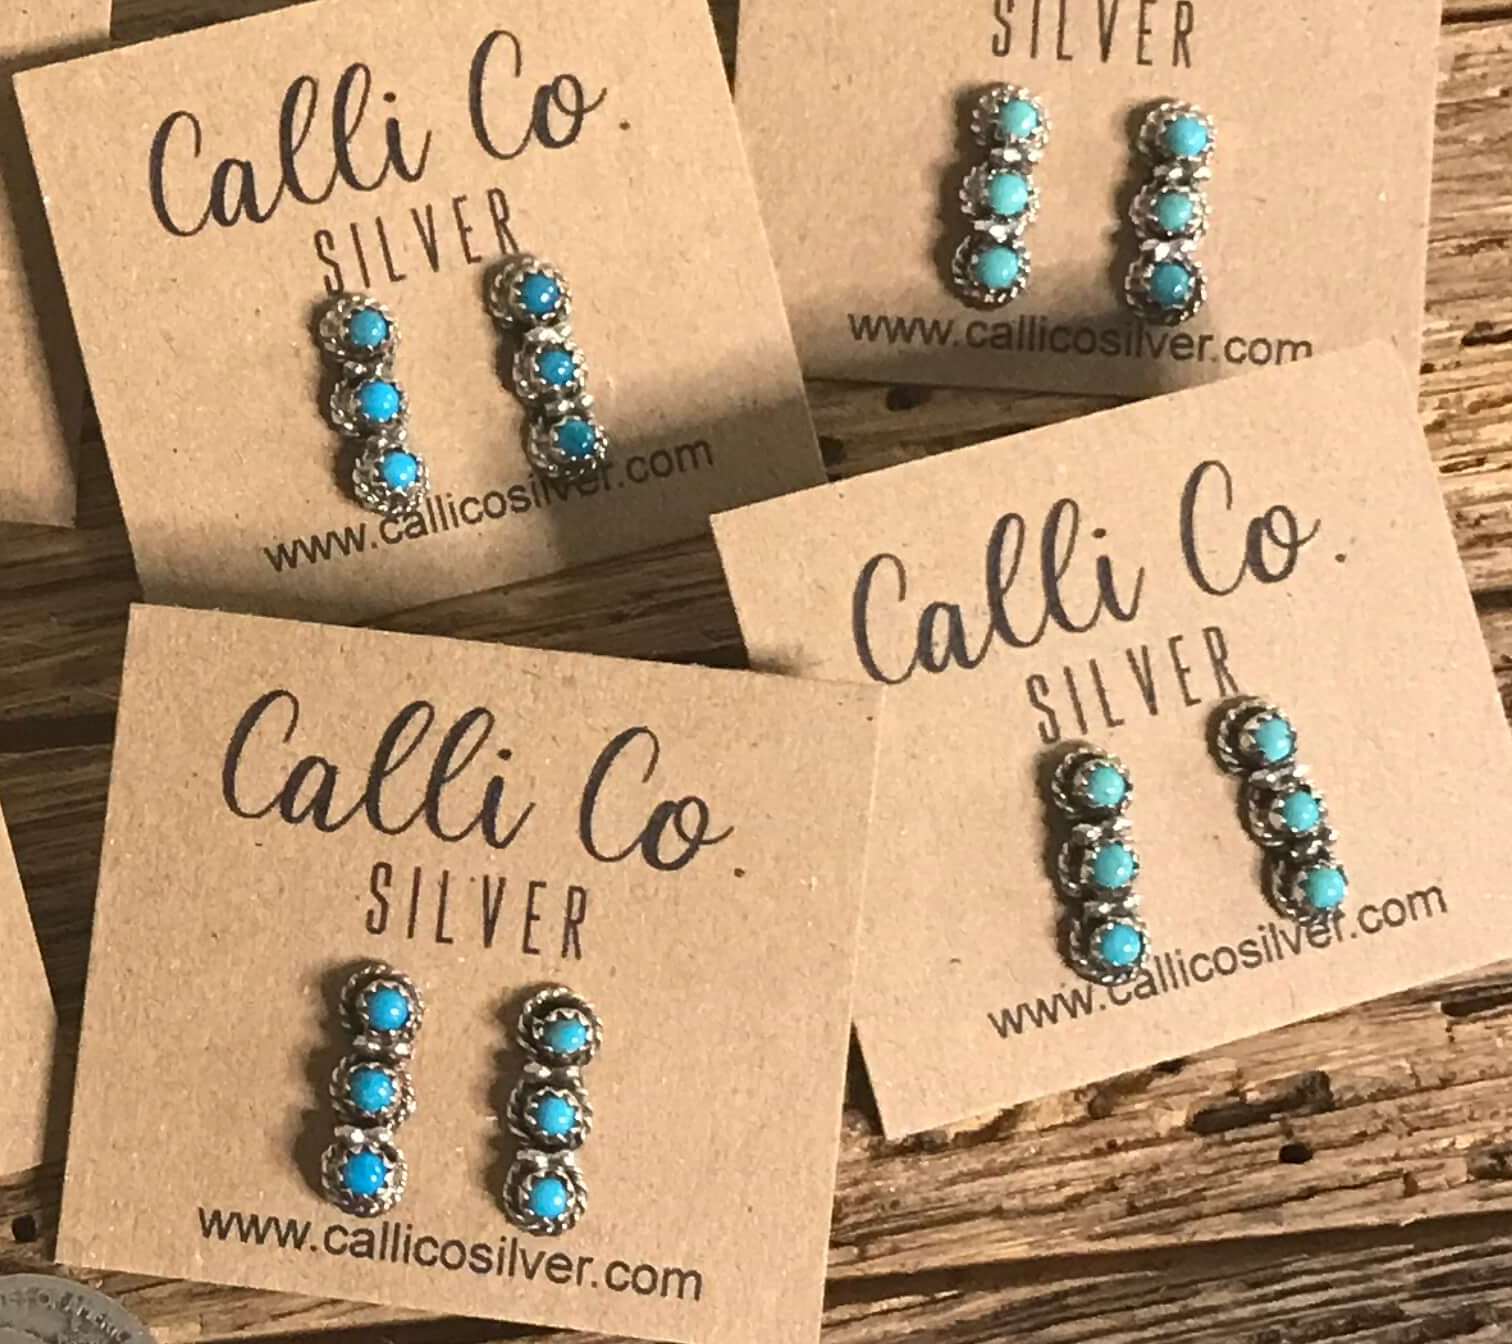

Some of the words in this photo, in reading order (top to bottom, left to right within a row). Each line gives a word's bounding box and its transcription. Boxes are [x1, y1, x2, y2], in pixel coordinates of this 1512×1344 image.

[149, 62, 432, 237] Calli
[469, 29, 631, 160] Co.
[313, 187, 521, 295] SILVER
[848, 310, 1313, 365] www.callicosilver.com
[851, 498, 1145, 686] Calli
[1180, 459, 1348, 596] Co.
[1026, 626, 1241, 744] SILVER
[221, 688, 536, 850] Calli
[579, 725, 746, 879] Co.
[365, 861, 588, 961] SILVER
[197, 1205, 704, 1301] www.callicosilver.com
